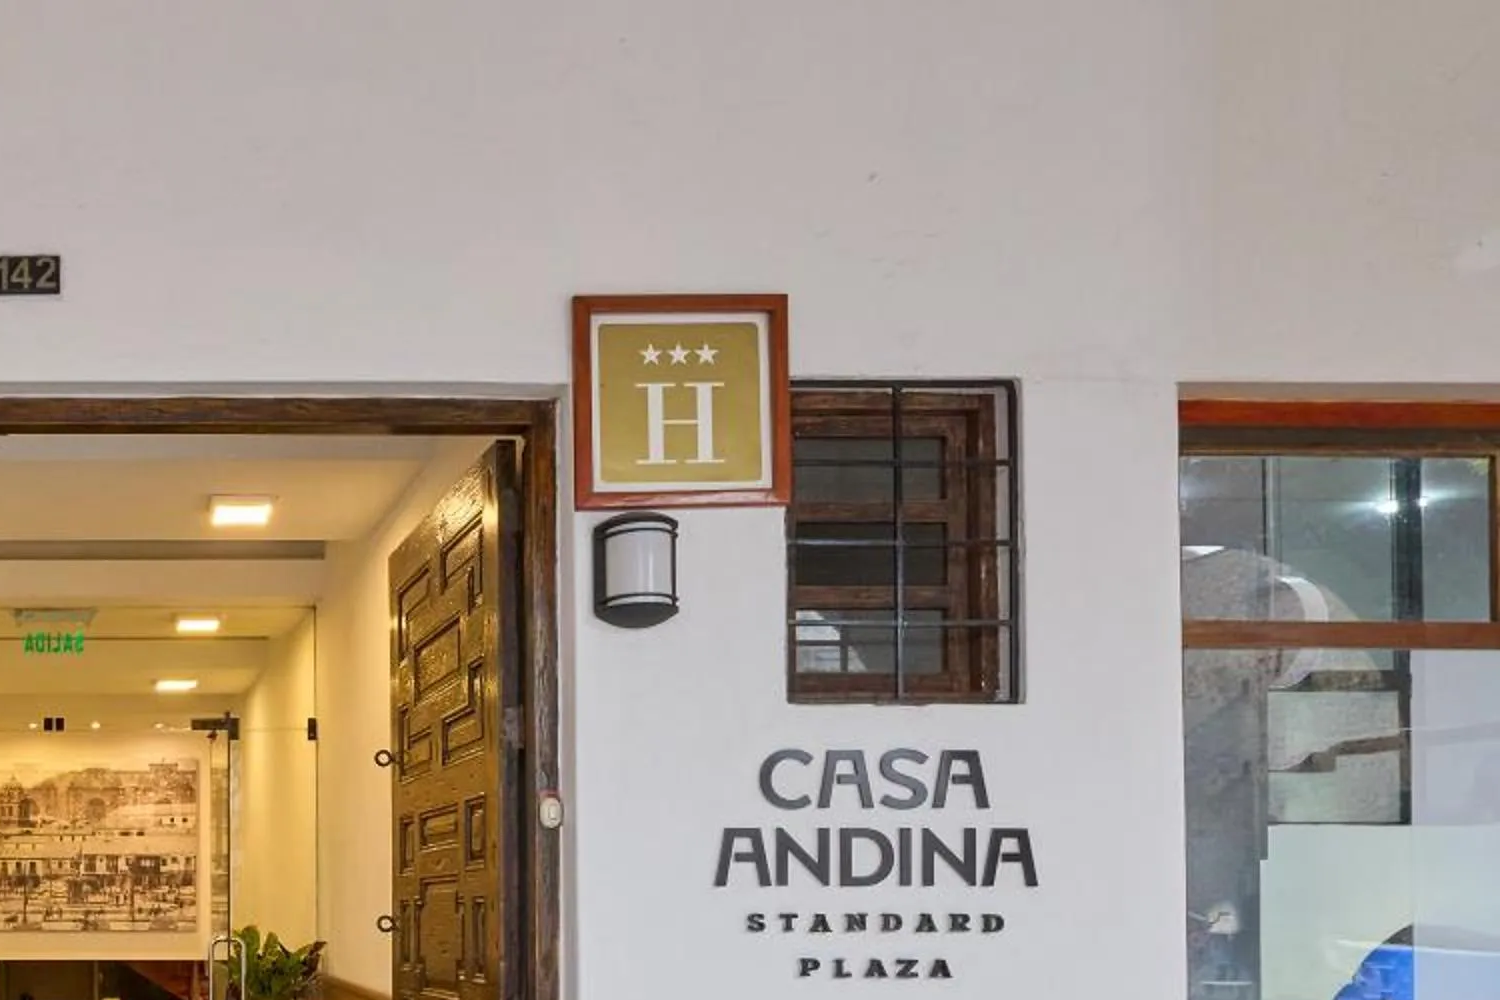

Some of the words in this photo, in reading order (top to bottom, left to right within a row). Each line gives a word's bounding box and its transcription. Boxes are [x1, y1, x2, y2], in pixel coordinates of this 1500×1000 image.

[635, 382, 725, 464] H
[758, 748, 991, 811] CASA
[713, 827, 1039, 887] ANDINA
[746, 912, 1006, 934] STANDARD
[797, 957, 954, 979] PLAZA
